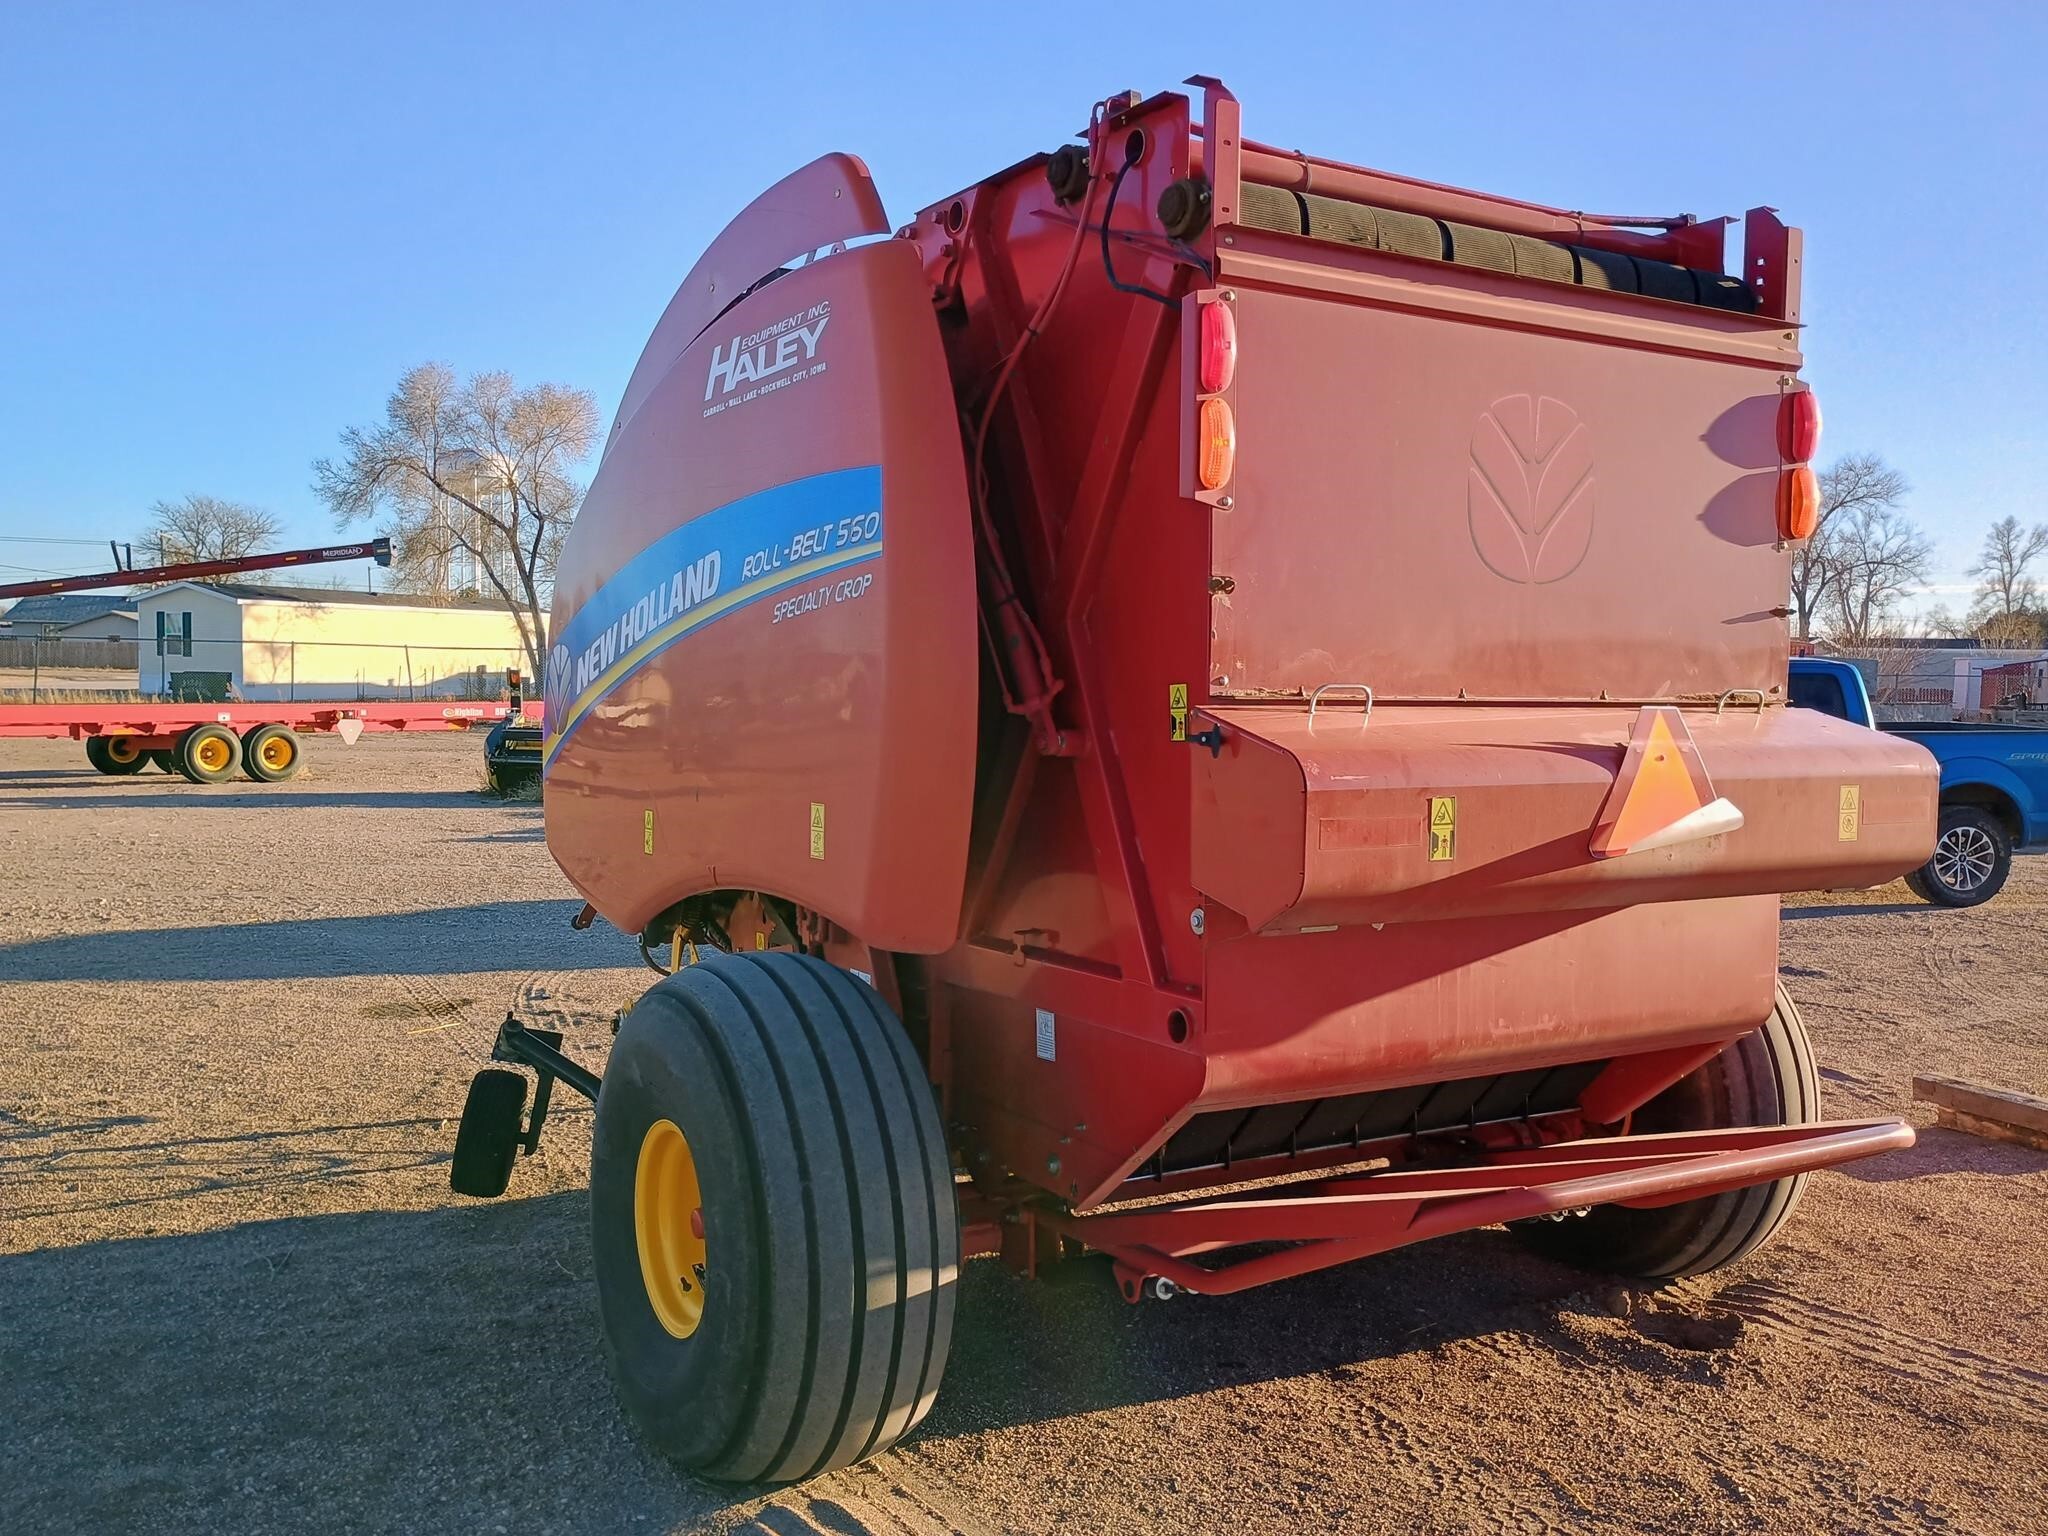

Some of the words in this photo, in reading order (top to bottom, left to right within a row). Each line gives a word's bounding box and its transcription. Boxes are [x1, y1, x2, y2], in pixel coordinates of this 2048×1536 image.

[741, 311, 805, 350] EQUIPMENT
[807, 301, 831, 320] INC.
[704, 316, 830, 401] HALEY
[809, 362, 827, 376] IOWA
[322, 547, 359, 557] MERIDIAN
[836, 511, 881, 547] 560
[576, 621, 619, 696] NEW
[619, 549, 721, 655] HOLLAND
[772, 584, 834, 624] SPECIALTY
[834, 573, 873, 603] CROP
